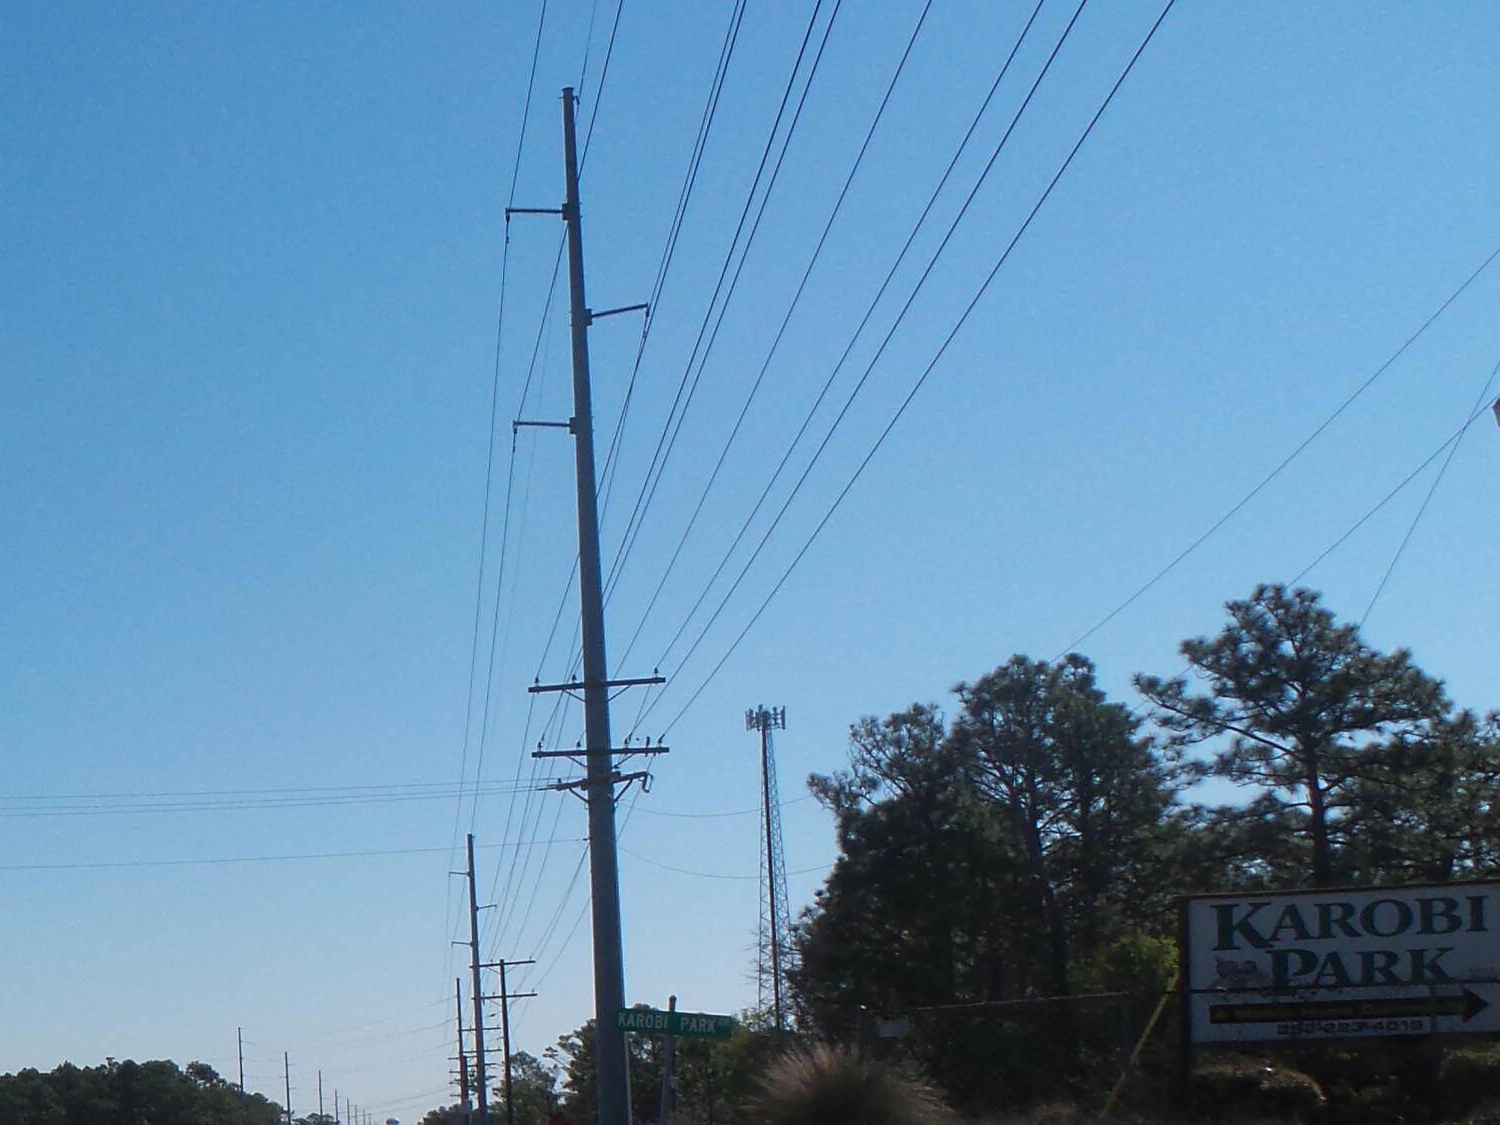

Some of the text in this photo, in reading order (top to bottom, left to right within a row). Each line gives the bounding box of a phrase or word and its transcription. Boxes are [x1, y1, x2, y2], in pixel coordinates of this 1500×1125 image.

[1210, 895, 1490, 951] KAROBI
[1266, 946, 1455, 995] PARK
[618, 1012, 716, 1034] KAROBI PARK
